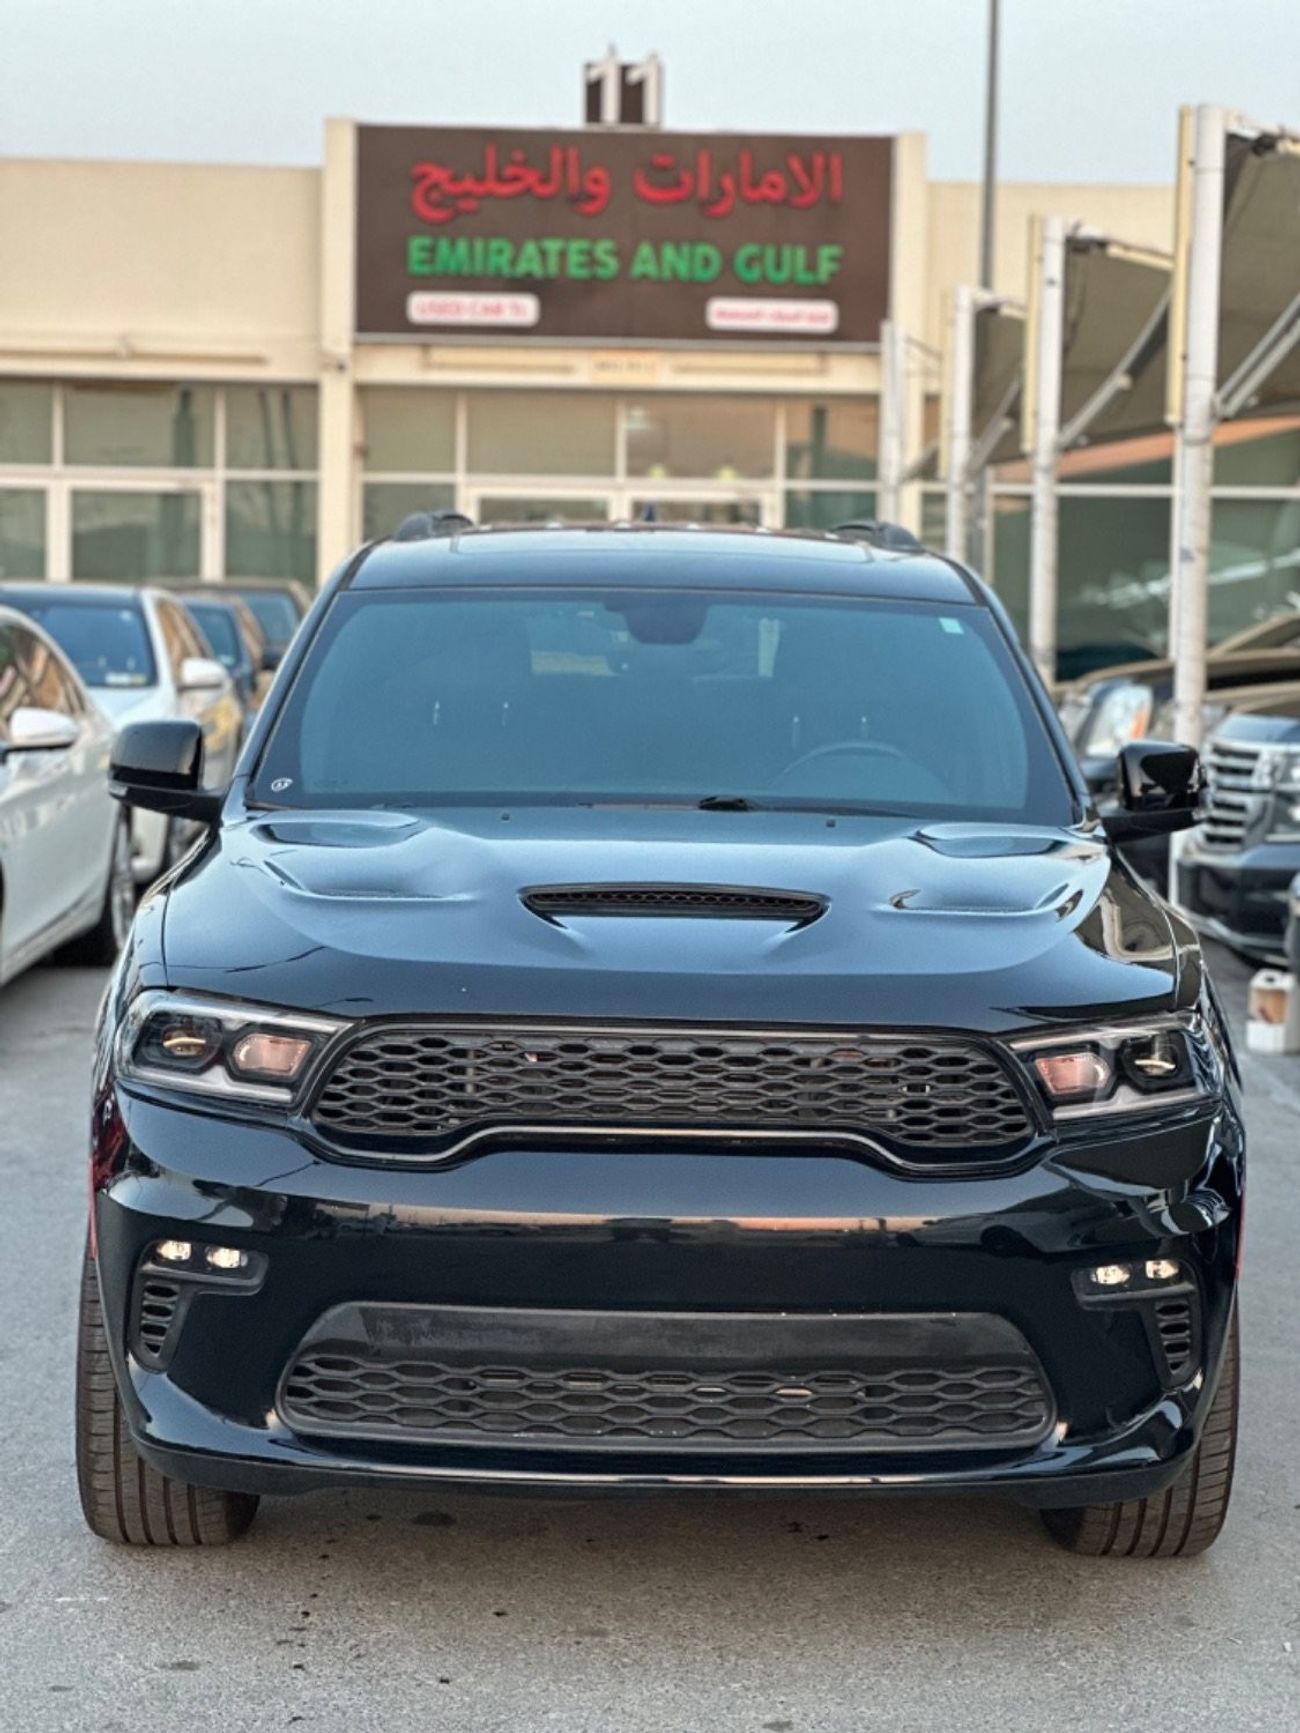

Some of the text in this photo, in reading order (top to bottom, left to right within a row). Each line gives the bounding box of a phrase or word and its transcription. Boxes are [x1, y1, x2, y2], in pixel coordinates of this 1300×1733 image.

[586, 55, 660, 122] 11
[411, 143, 843, 222] الامارات والخليج
[408, 236, 843, 285] EMIRATES AND GULF
